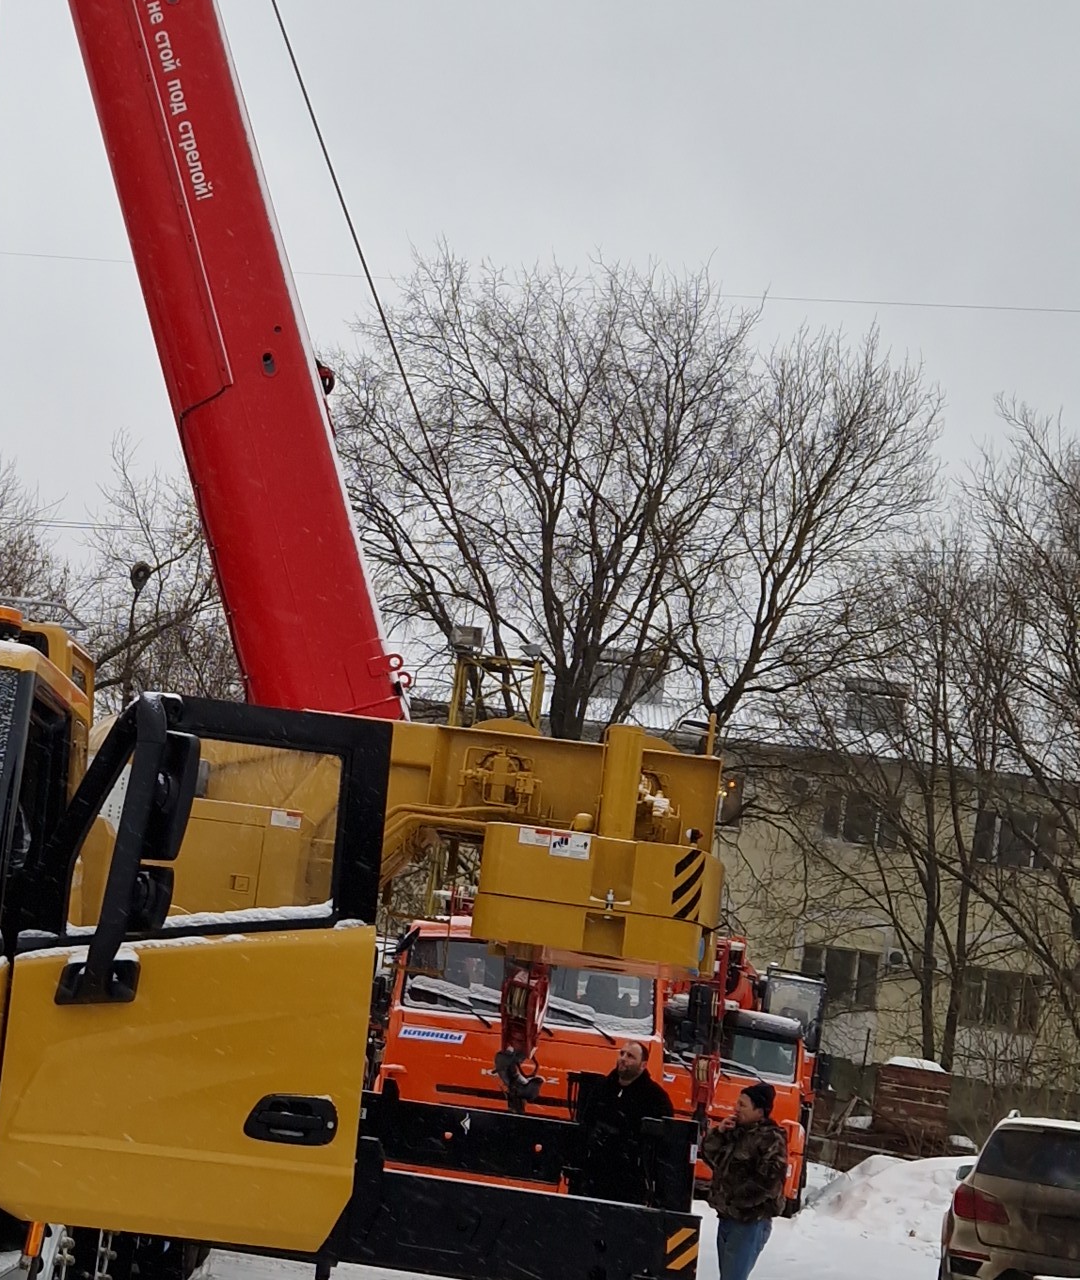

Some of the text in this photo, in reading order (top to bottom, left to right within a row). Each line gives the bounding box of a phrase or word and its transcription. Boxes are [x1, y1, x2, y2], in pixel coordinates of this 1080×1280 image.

[147, 0, 214, 201] не стой под стрелой!
[403, 1029, 463, 1041] КЛИНЦЫ
